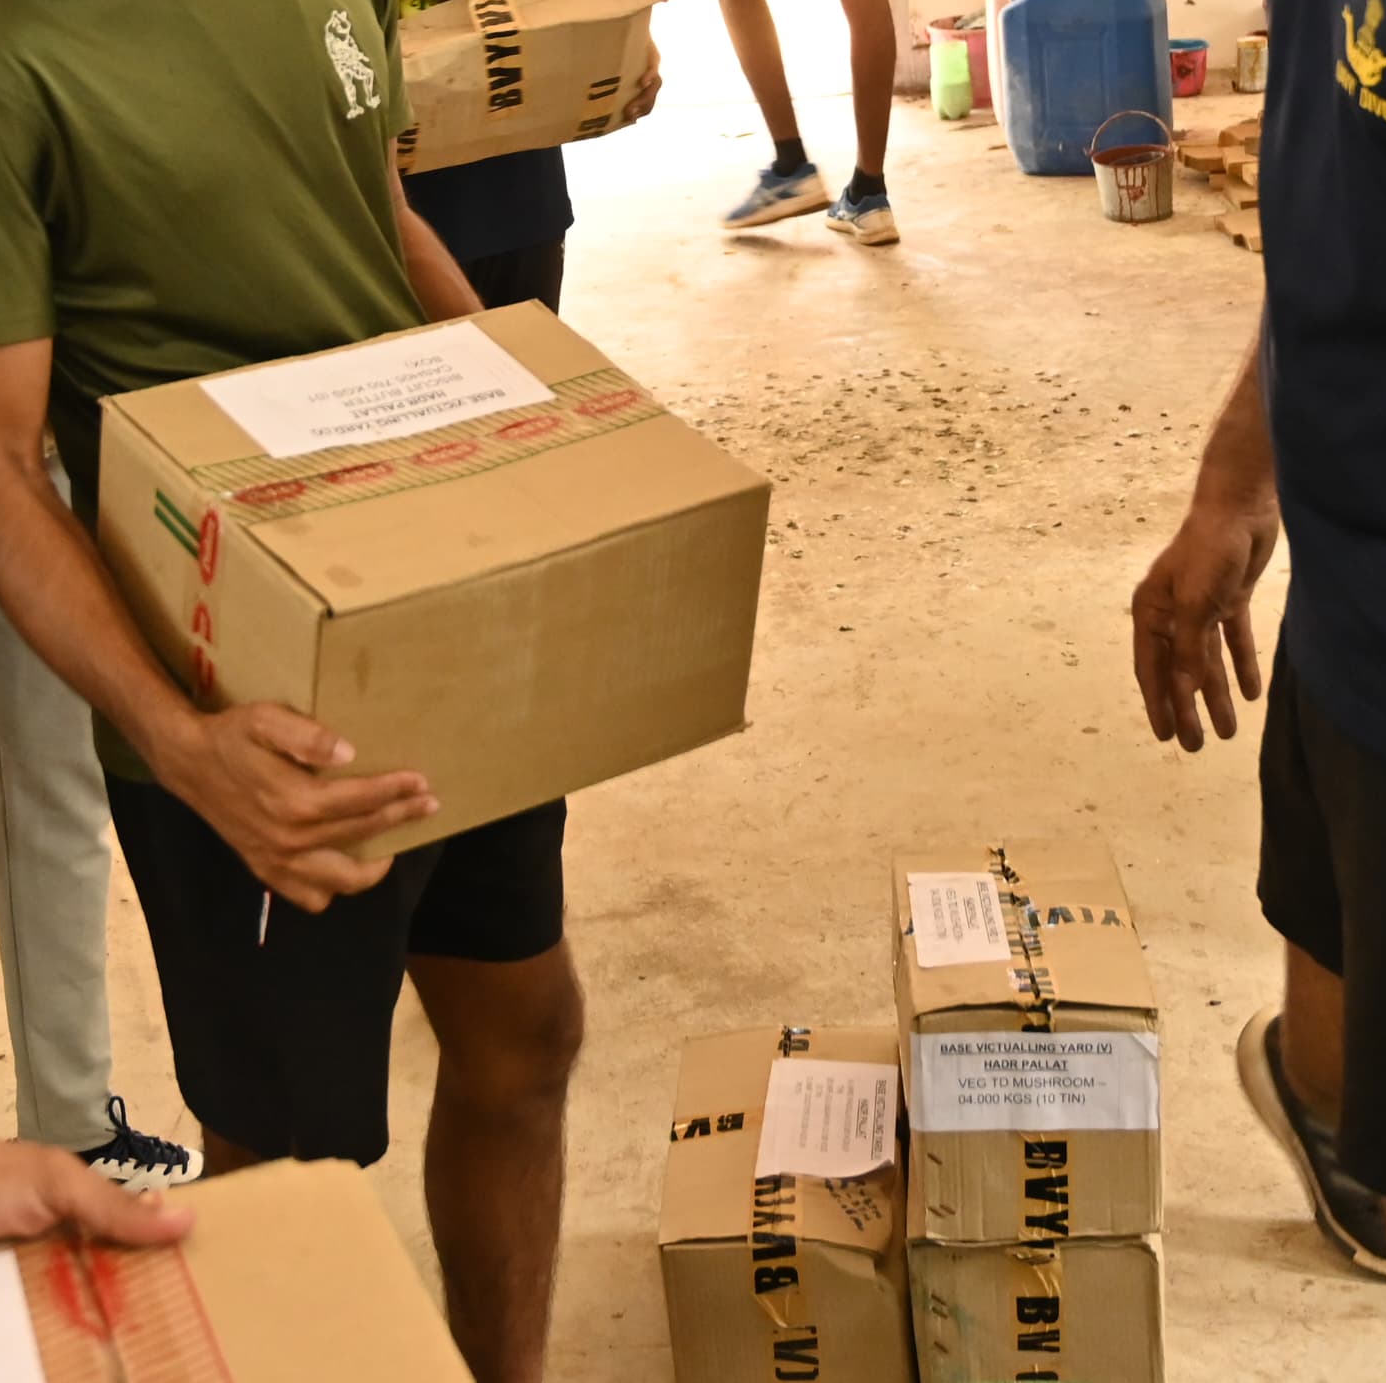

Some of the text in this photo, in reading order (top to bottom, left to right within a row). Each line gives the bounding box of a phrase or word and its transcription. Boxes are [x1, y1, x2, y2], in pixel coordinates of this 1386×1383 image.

[940, 1043, 1113, 1055] BASE VICTUALLING YARD (V)
[984, 1059, 1068, 1071] HADR PALLAT
[958, 1077, 987, 1089] VEG
[992, 1077, 1009, 1088] TD
[1013, 1076, 1095, 1088] MUSHROOM
[958, 1093, 1086, 1105] 04.000 KGS (10 TIN)
